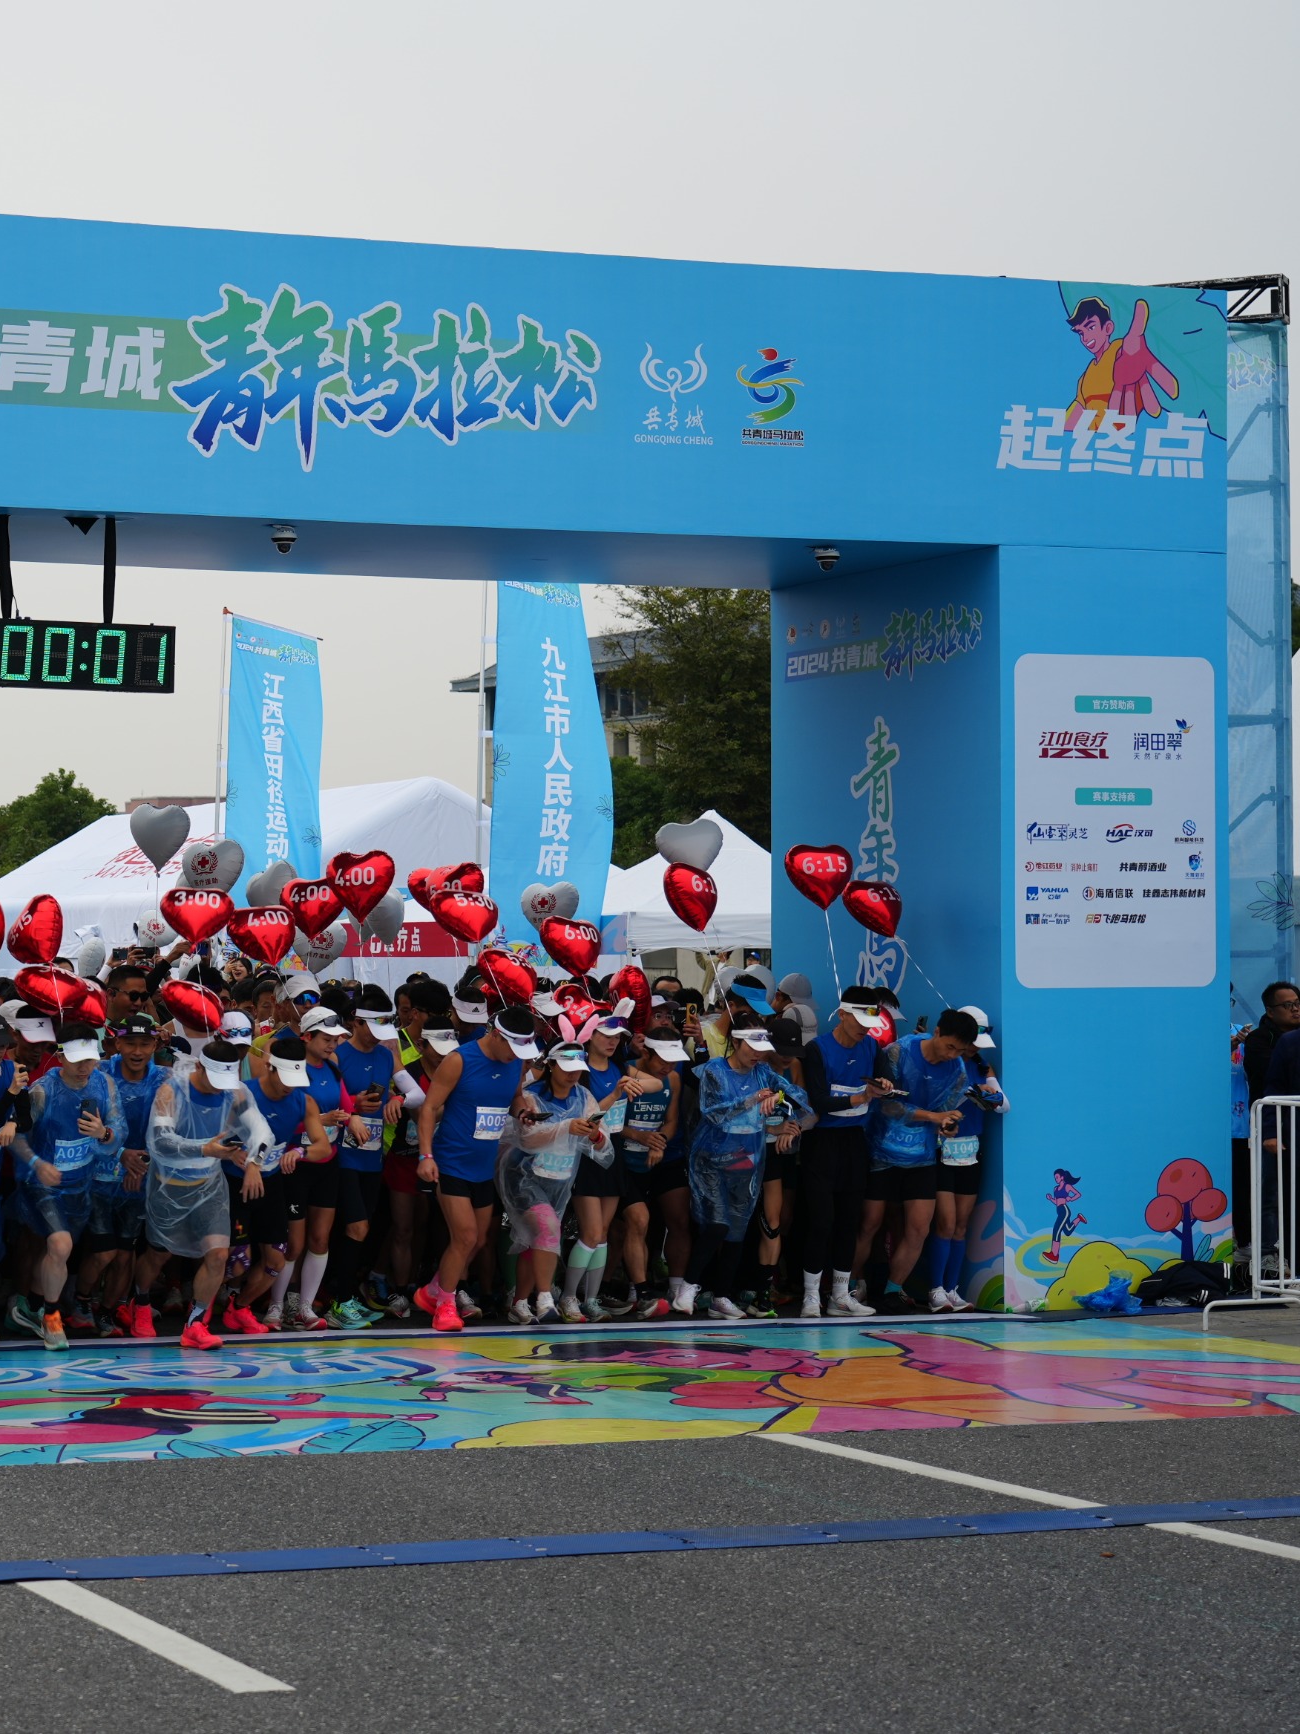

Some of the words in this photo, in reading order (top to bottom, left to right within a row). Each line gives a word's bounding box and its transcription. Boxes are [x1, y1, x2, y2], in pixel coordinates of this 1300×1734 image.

[642, 403, 706, 434] 共青城
[634, 433, 683, 445] GONGQING
[683, 436, 714, 446] CHENG
[741, 428, 804, 441] 共青城马拉松
[996, 404, 1208, 479] 起终点
[1092, 699, 1135, 710] 官方赞助商
[1039, 731, 1109, 748] 江中食疗
[1133, 733, 1183, 752] 润田翠
[536, 637, 574, 877] 九江市人民政府
[1133, 752, 1183, 760] 天然矿泉水
[261, 671, 290, 872] 江西省田径运动
[1092, 791, 1136, 802] 赛事支持商
[802, 856, 848, 875] 6:15
[335, 867, 375, 887] 4:00
[691, 874, 717, 895] 6:1
[174, 890, 221, 909] 3:00
[290, 885, 330, 903] 4:00
[454, 893, 494, 911] 5:30
[1095, 888, 1134, 899] 海盾信联
[248, 910, 289, 928] 4:00
[1102, 913, 1147, 924] 飞跑马拉松
[564, 924, 599, 943] 6:00
[563, 994, 592, 1021] 3:4
[478, 1113, 506, 1128] A005
